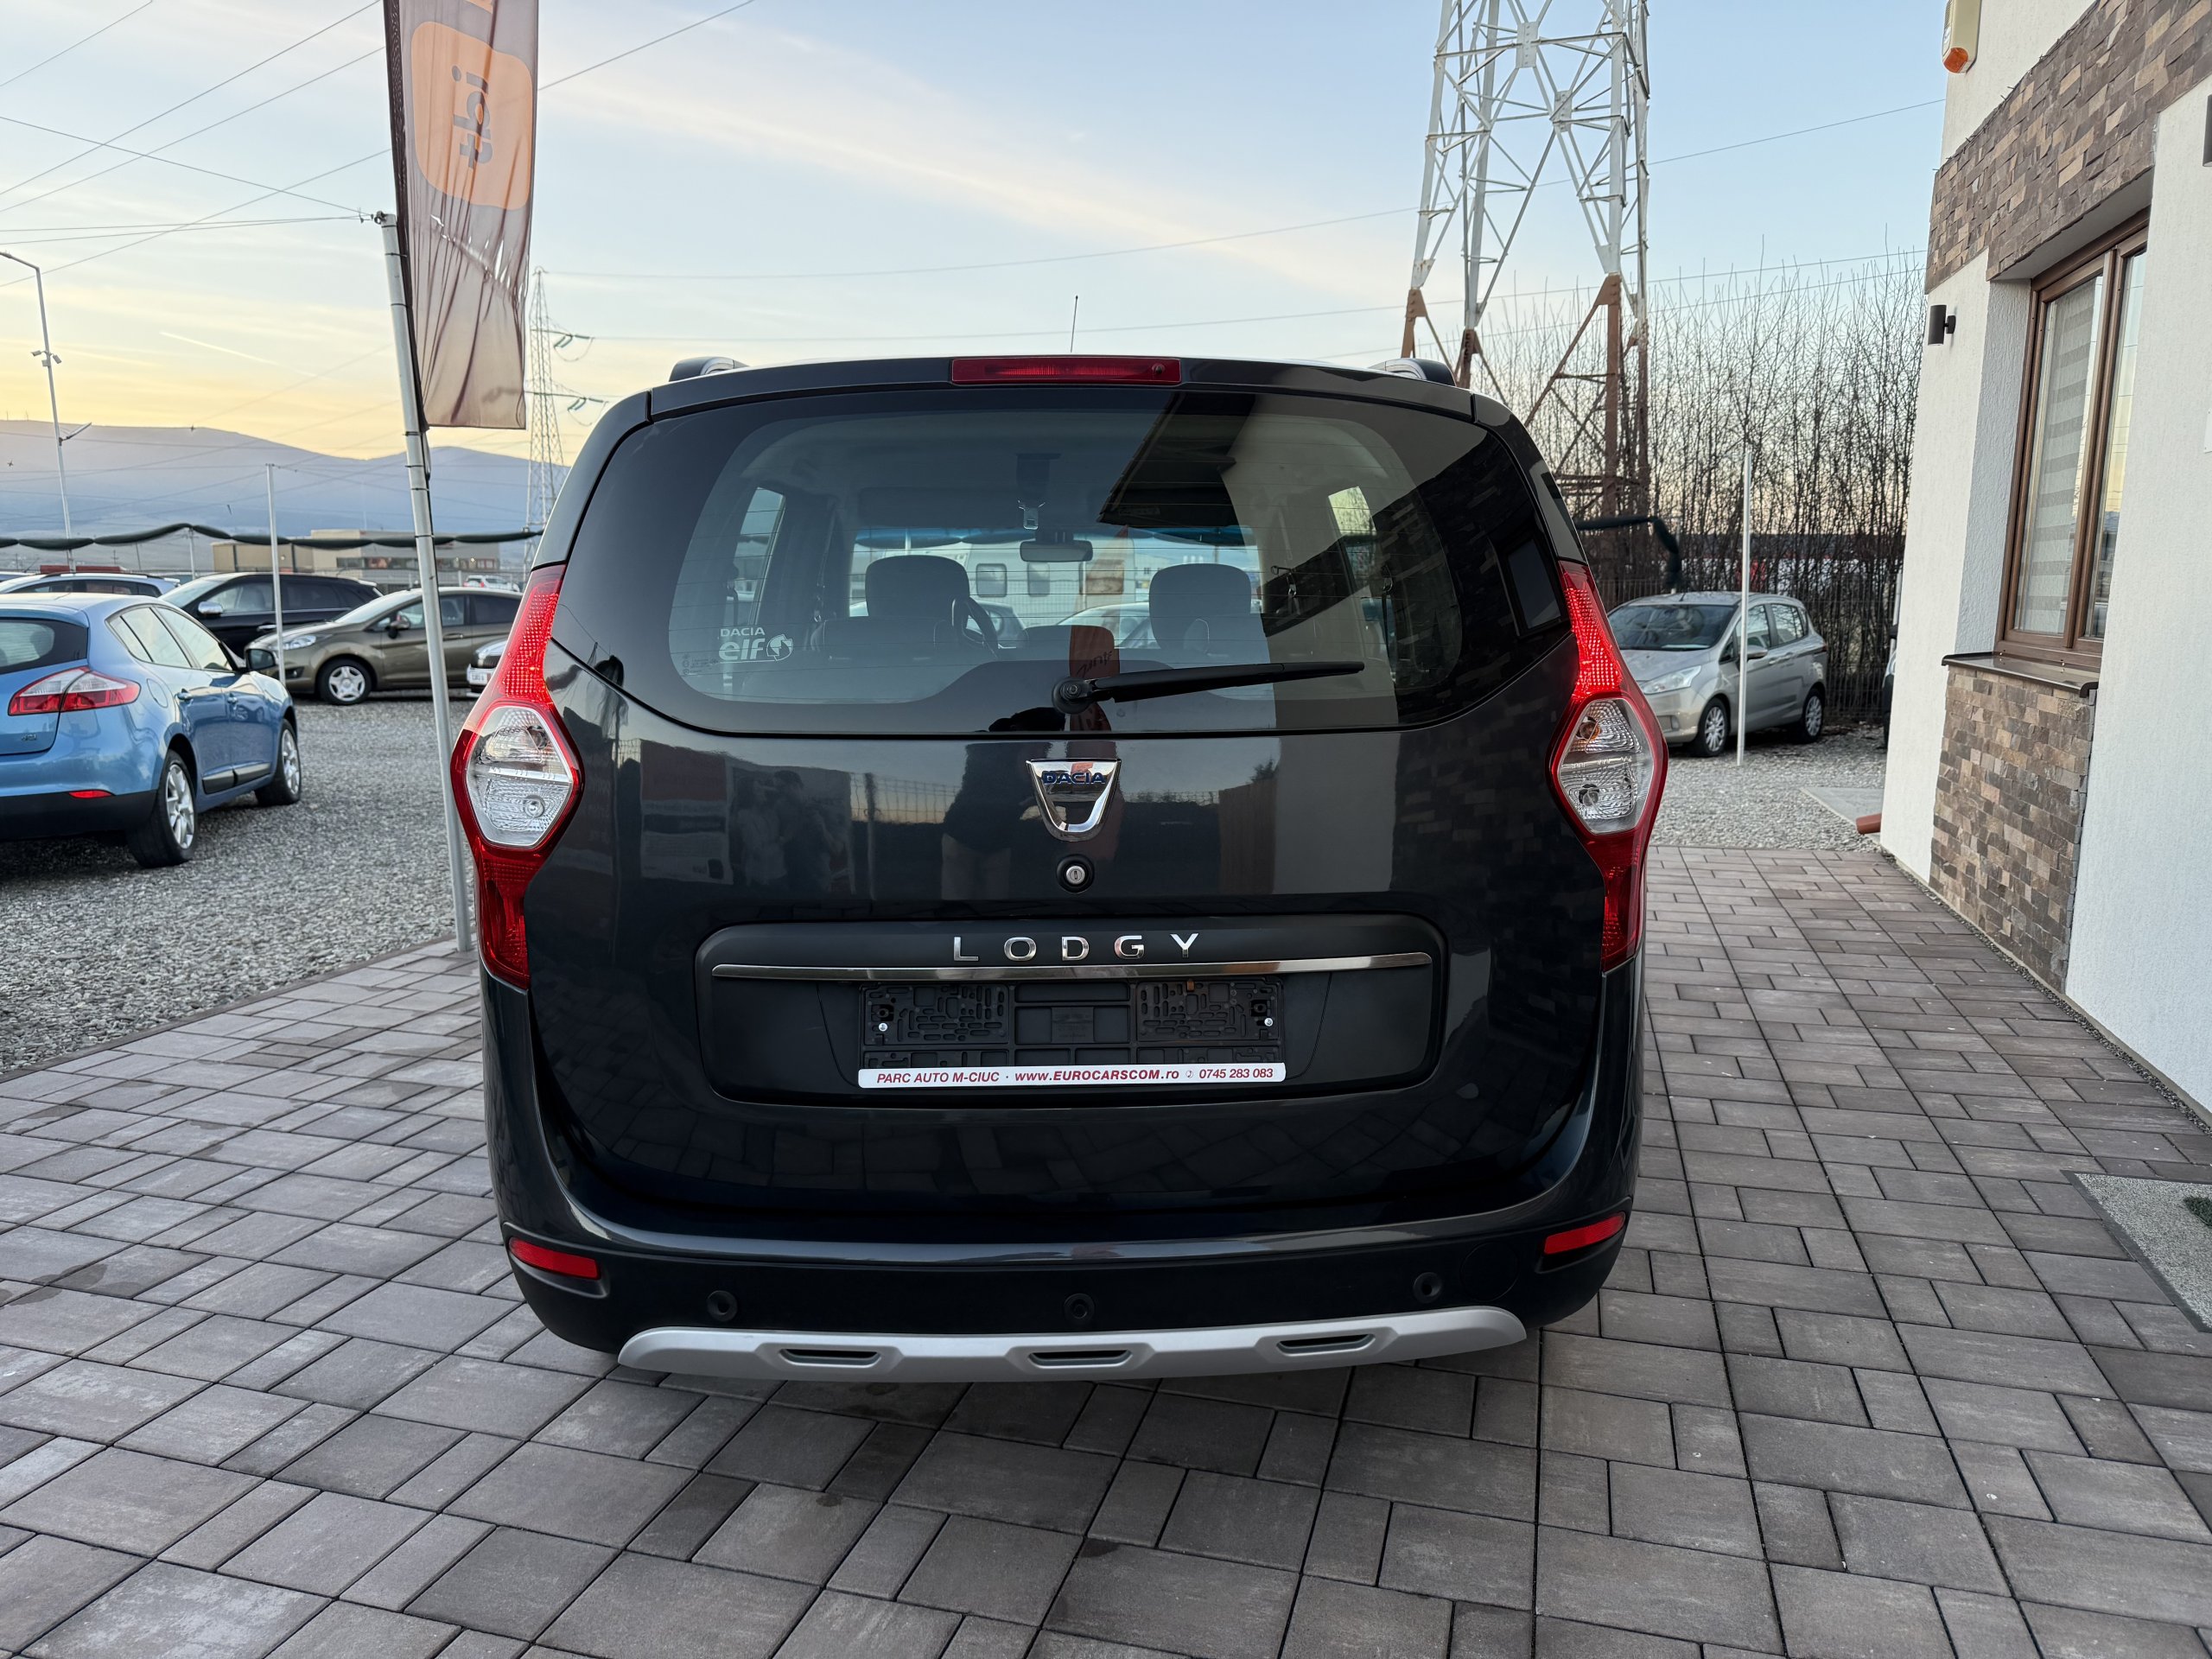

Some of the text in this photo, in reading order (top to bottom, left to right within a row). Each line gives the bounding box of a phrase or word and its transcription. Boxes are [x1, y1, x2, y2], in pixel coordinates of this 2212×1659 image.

[451, 65, 493, 170] tbi
[720, 626, 766, 637] DACIA
[718, 638, 766, 660] elf
[1042, 772, 1106, 785] DACIA
[953, 932, 1199, 963] LODGY
[876, 1068, 1274, 1084] PARC AUTO M-CIUC www.EUROCARSCOM.ro 0745 283 083
